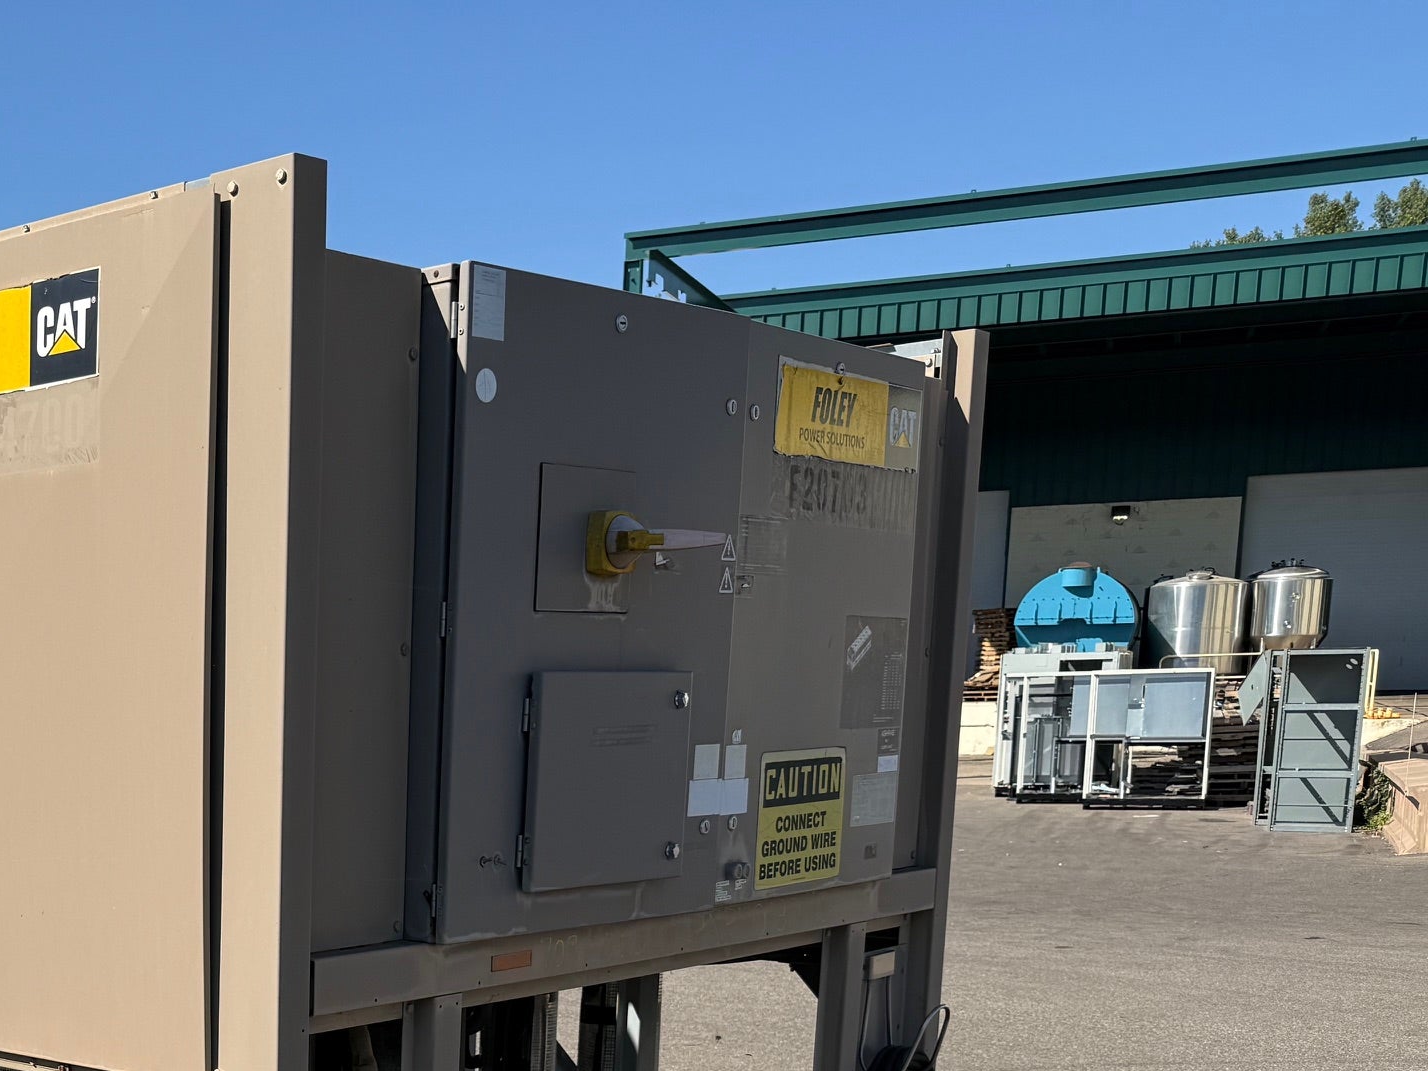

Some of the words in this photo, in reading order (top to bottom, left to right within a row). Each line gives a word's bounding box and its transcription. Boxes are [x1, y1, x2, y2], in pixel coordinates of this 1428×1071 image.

[36, 297, 92, 358] CAT
[810, 386, 859, 429] FOLEY
[798, 427, 825, 444] POWER
[826, 431, 865, 450] SOLUTIONS
[889, 406, 917, 448] CAT
[765, 762, 842, 801] CAUTION
[775, 810, 827, 833] CONNECT
[761, 837, 808, 858] GROUND
[810, 831, 837, 849] WIRE
[758, 859, 801, 881] BEFORE
[804, 852, 836, 873] USING
